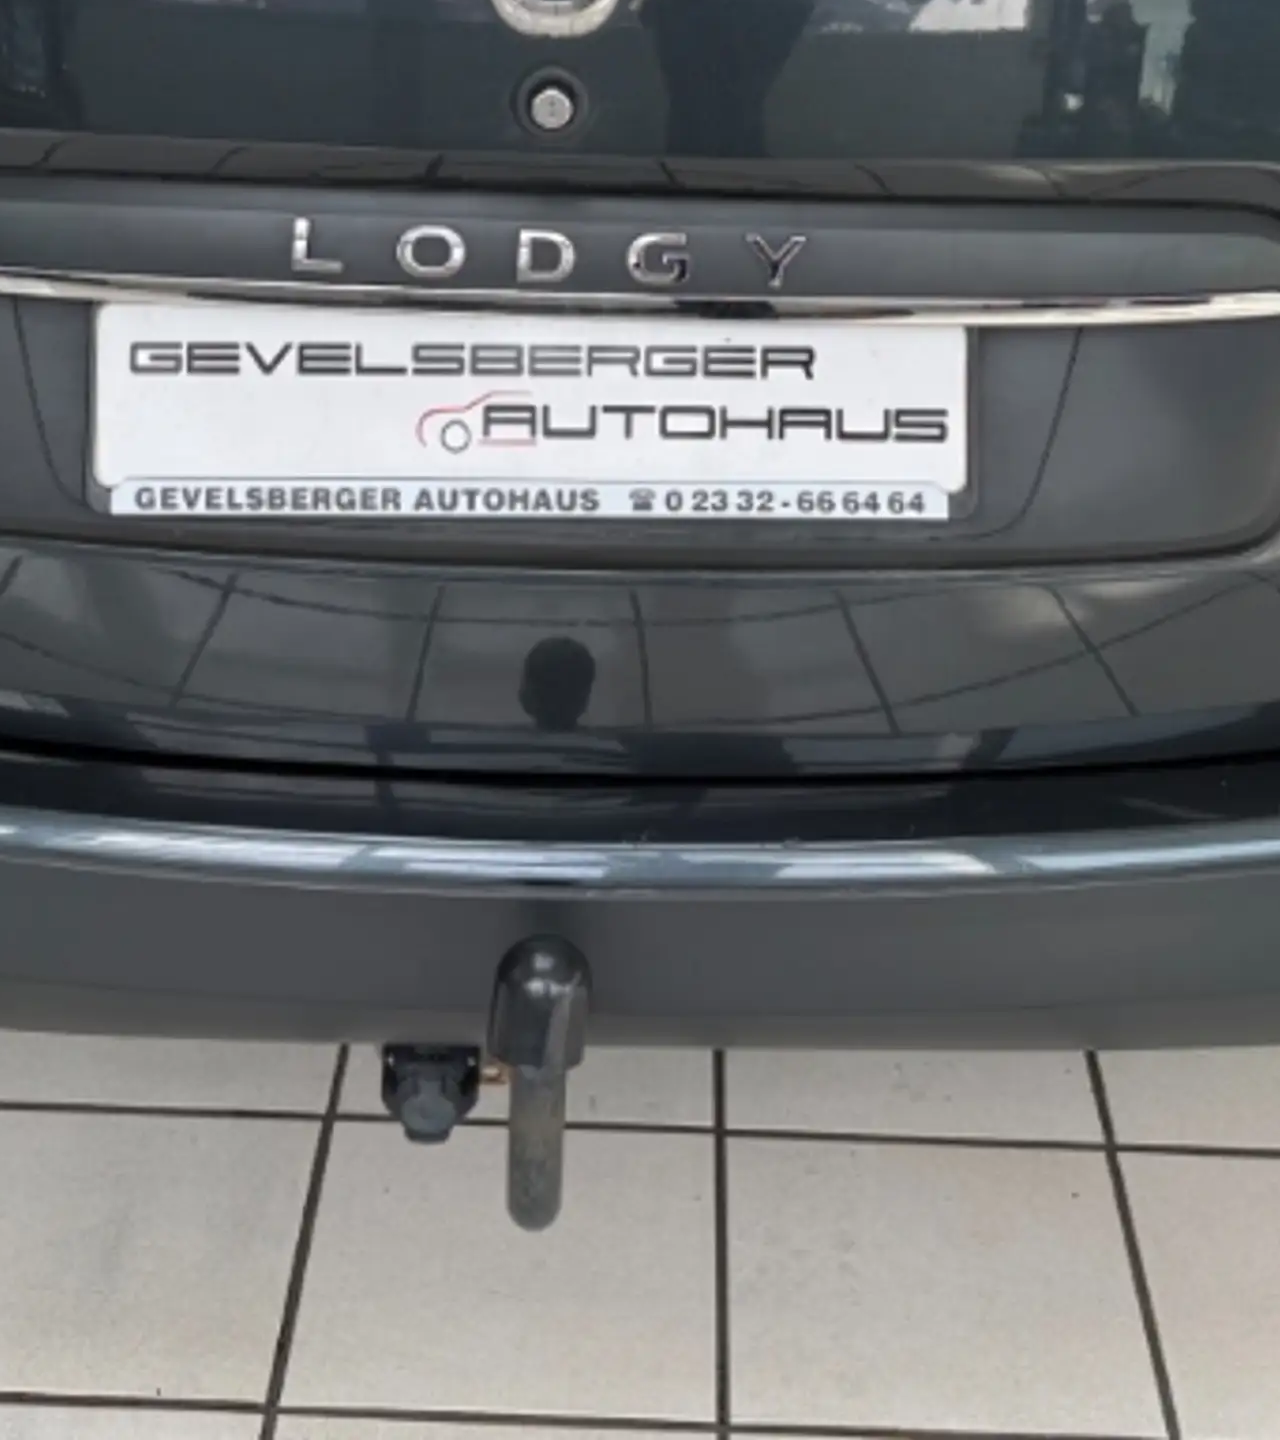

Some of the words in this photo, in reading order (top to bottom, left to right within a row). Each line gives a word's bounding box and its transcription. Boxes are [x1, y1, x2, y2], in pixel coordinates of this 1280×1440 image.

[291, 215, 808, 289] LODGY
[129, 341, 816, 380] GEVELSBERGER
[482, 404, 949, 443] AUTOHAUS
[134, 485, 403, 513] GEVELSBERGER
[413, 487, 601, 513] AUTOHAUS
